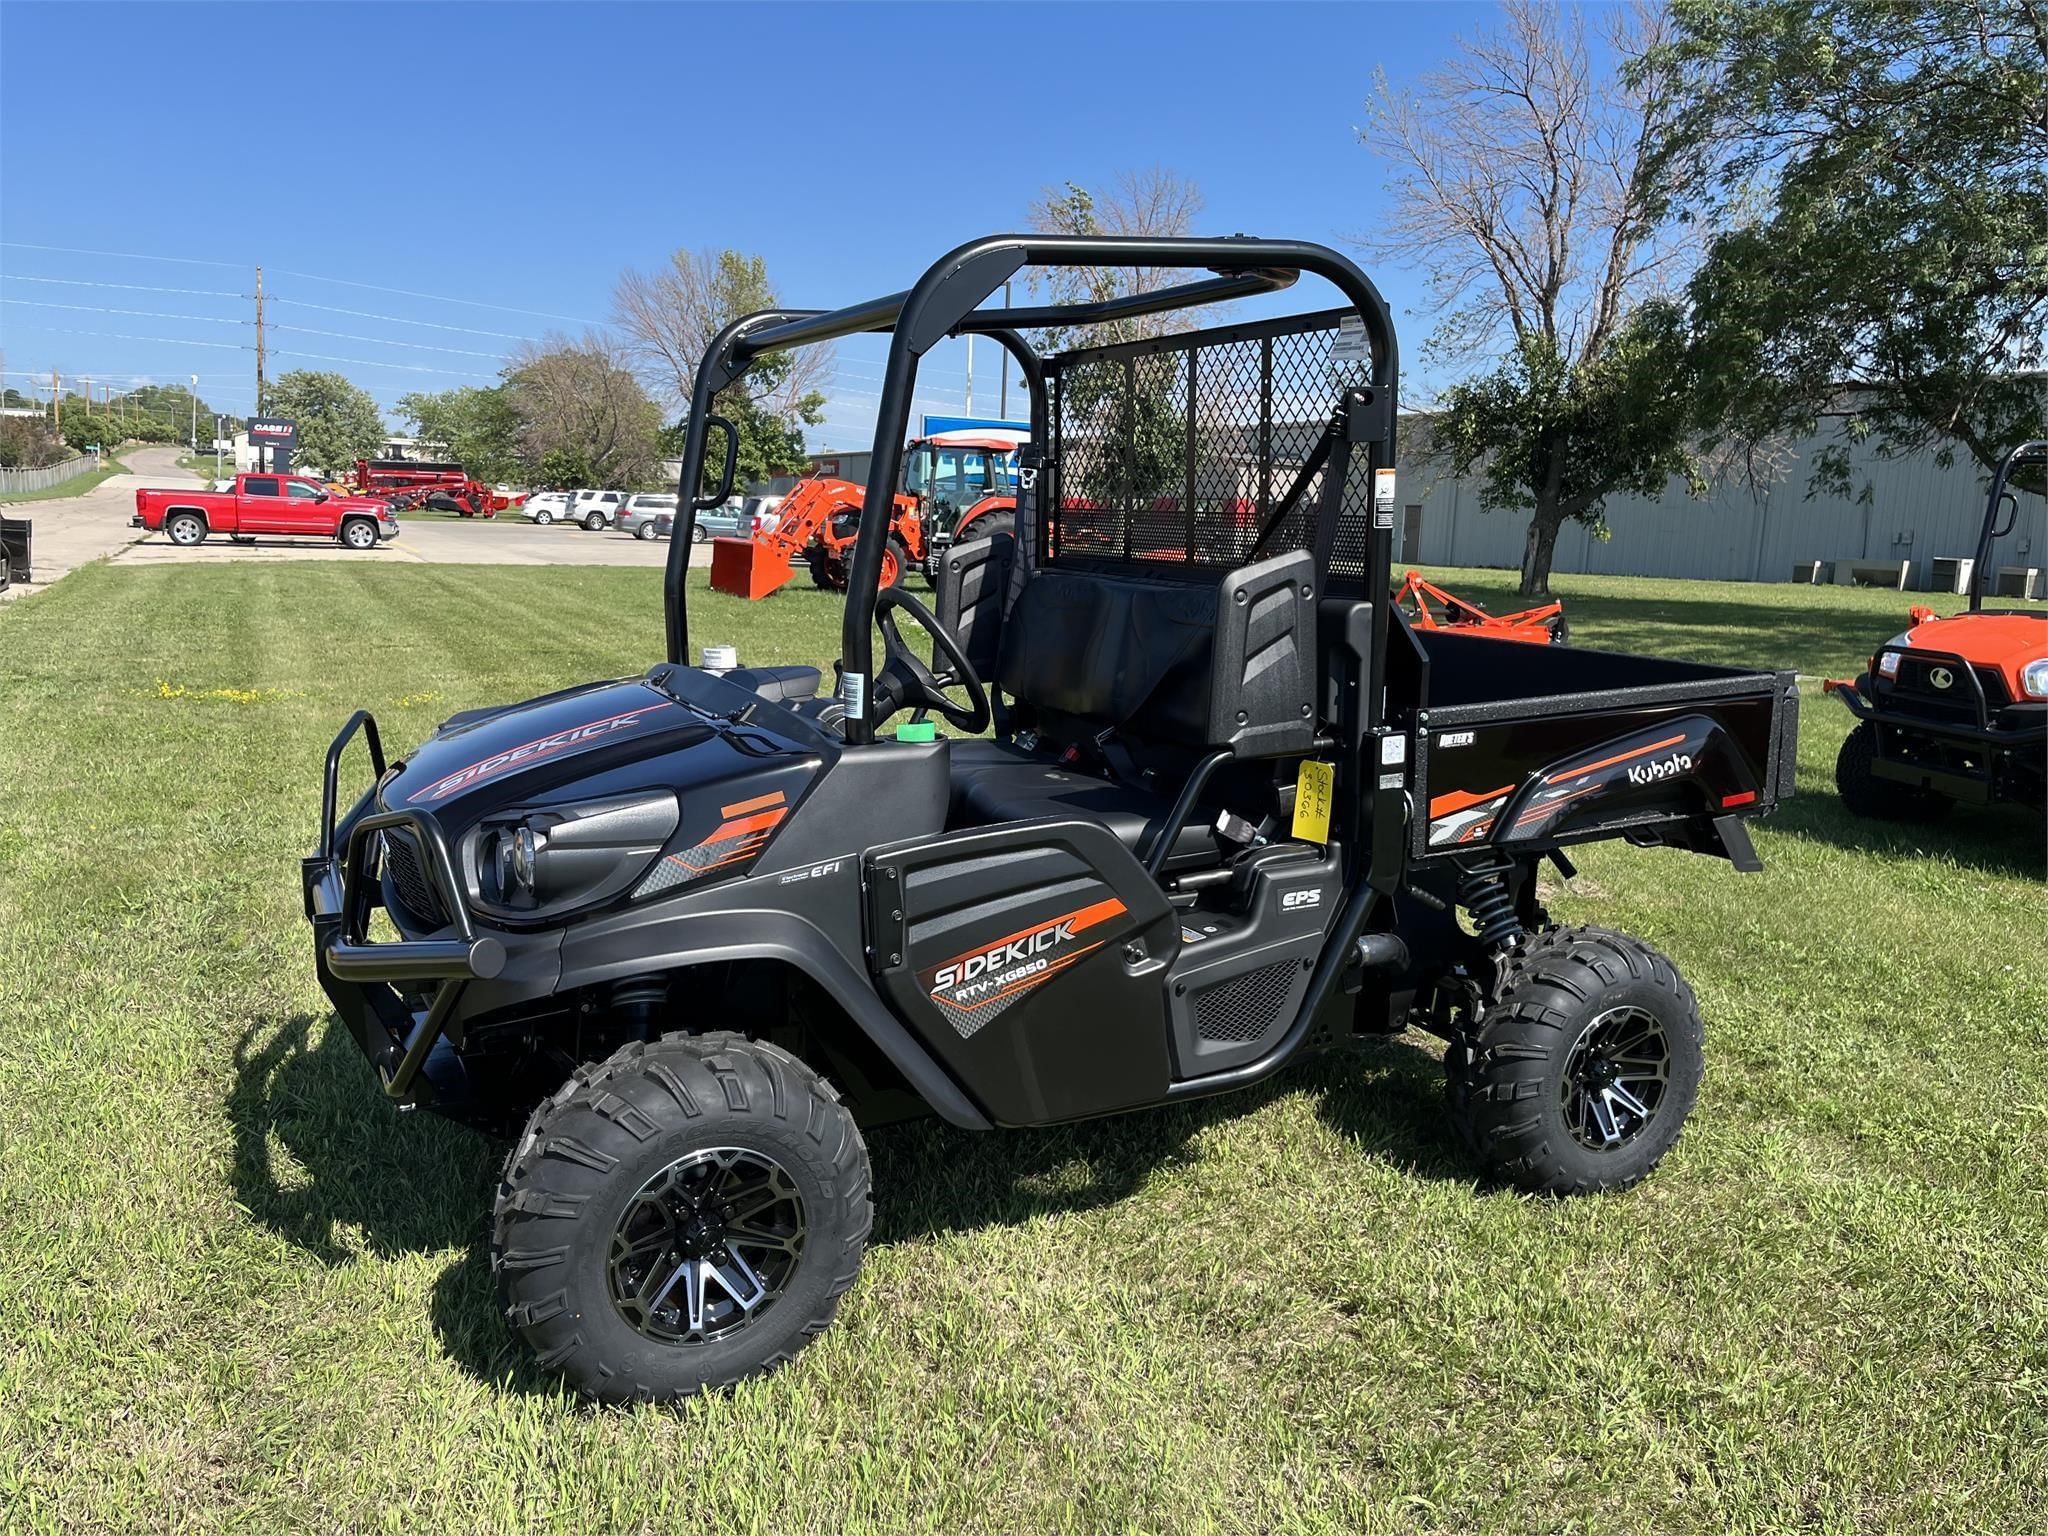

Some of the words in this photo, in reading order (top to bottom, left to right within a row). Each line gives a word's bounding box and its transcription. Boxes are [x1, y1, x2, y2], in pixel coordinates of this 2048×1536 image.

[253, 423, 283, 433] CASE
[432, 713, 640, 798] SIDEKICK
[1627, 753, 1693, 785] Kubota
[811, 861, 840, 878] EFI
[1282, 888, 1322, 907] EPS
[930, 917, 1077, 995] SIDEKICK
[955, 958, 1048, 1001] RTV-XG850
